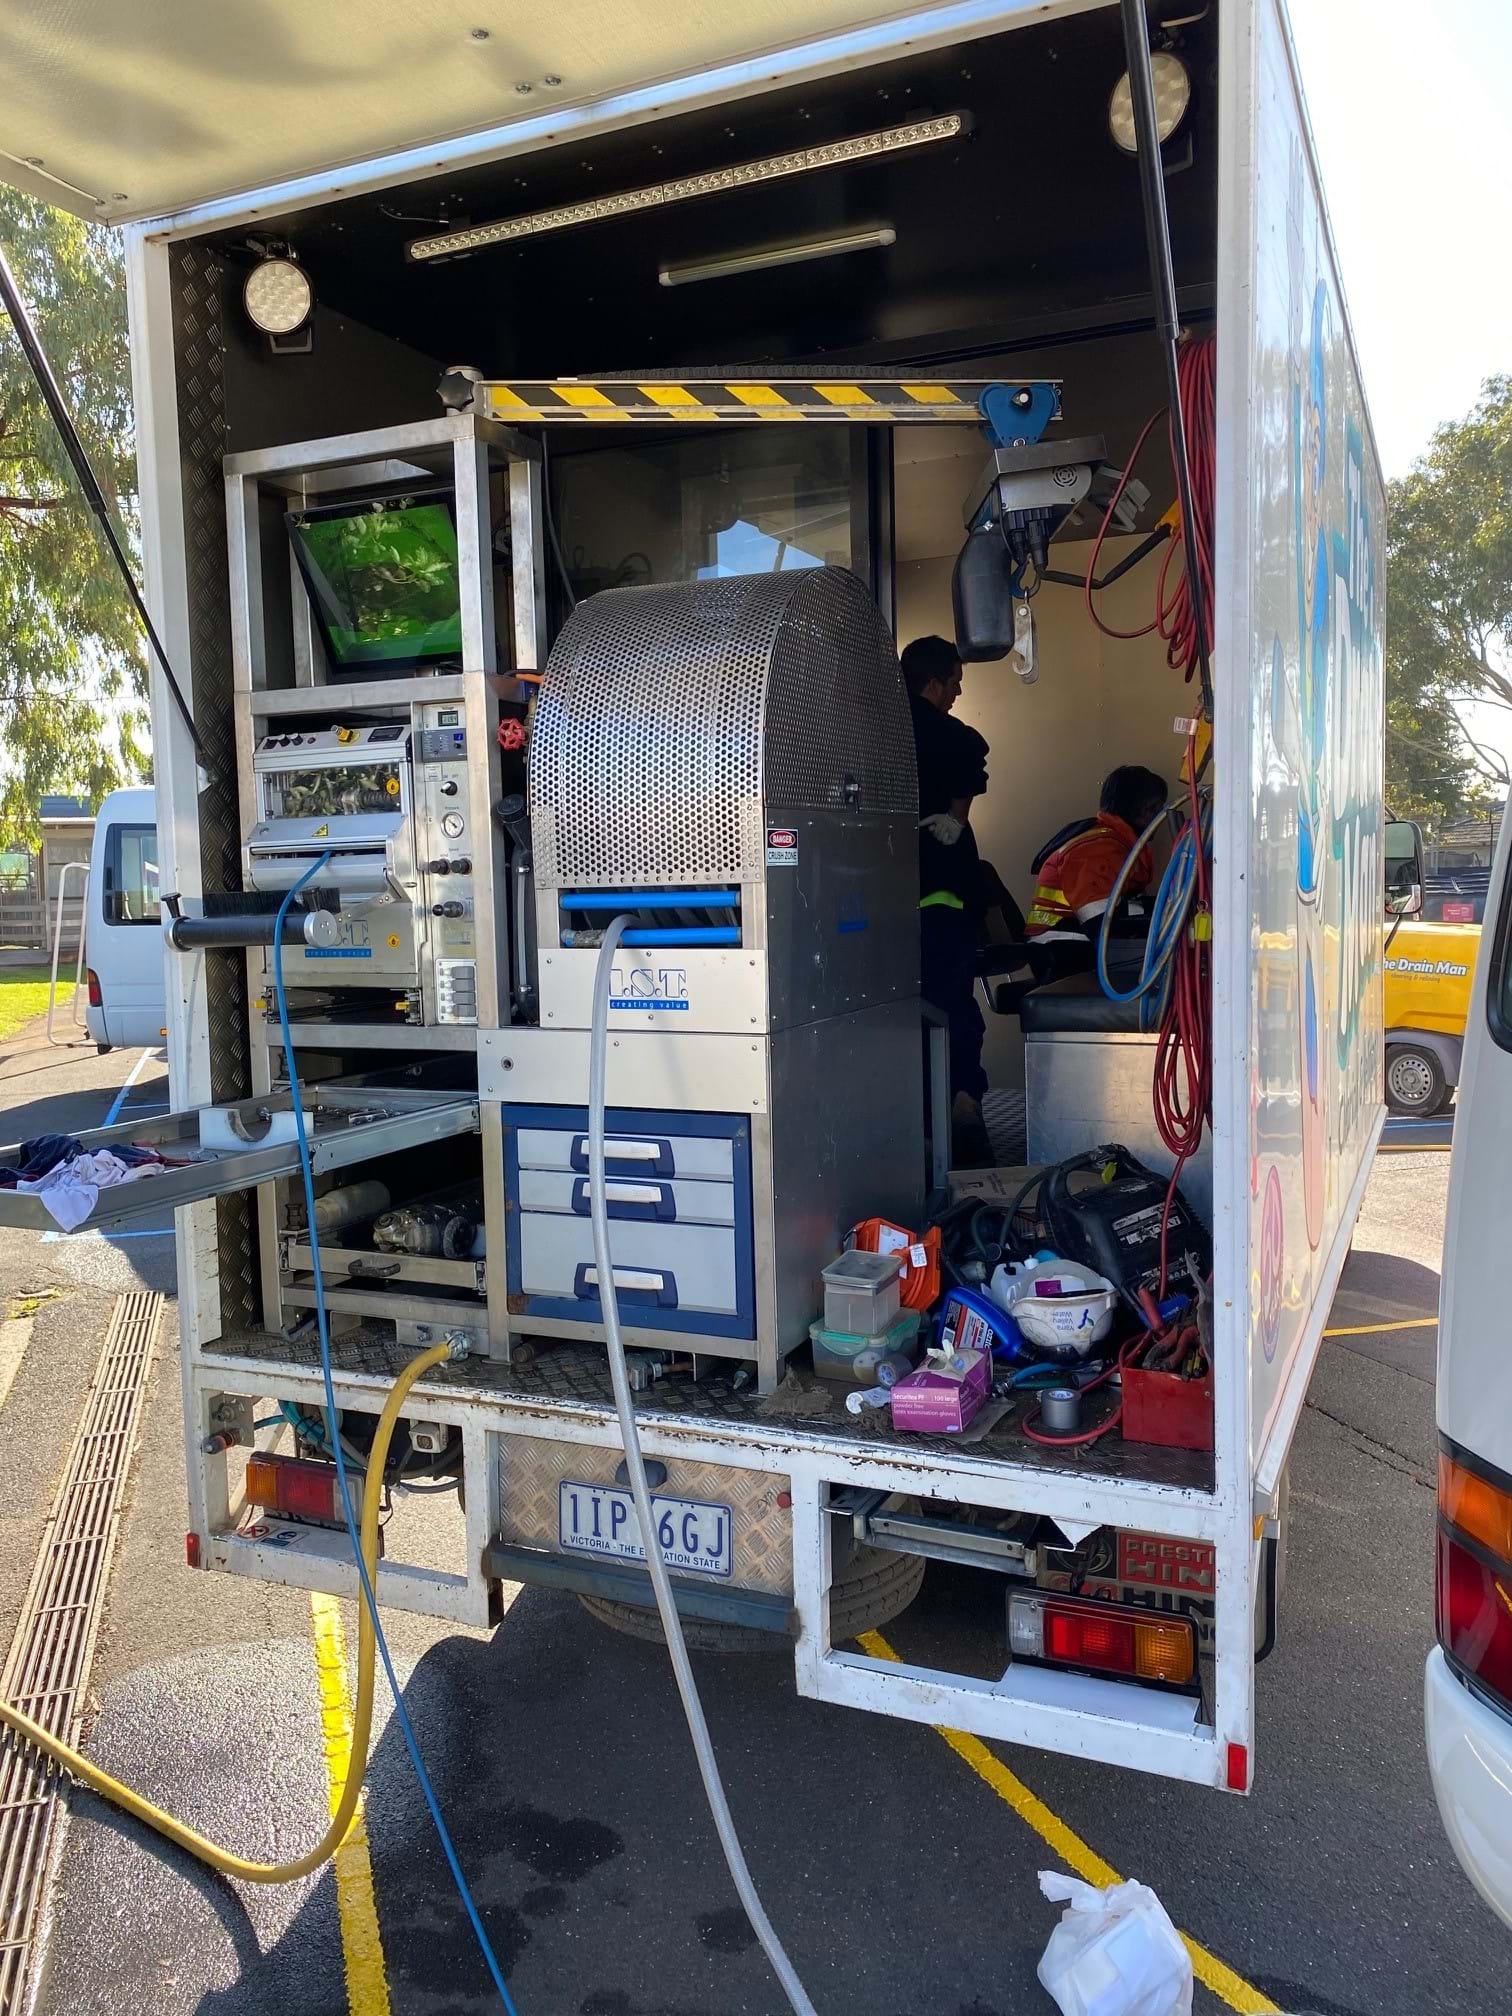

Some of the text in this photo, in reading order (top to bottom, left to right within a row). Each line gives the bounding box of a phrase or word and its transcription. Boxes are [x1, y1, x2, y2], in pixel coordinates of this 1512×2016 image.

[1349, 452, 1369, 628] The
[1334, 573, 1380, 821] Drain
[769, 852, 796, 860] CRUSH ZONE
[772, 834, 792, 844] DANGER
[1341, 815, 1376, 1035] Man
[1384, 958, 1467, 976] he Drain Man
[570, 1494, 723, 1557] 1IP 6GJ
[570, 1535, 610, 1550] VICTORIA
[620, 1544, 636, 1554] THE
[640, 1547, 690, 1564] EATION
[693, 1557, 720, 1569] STATE
